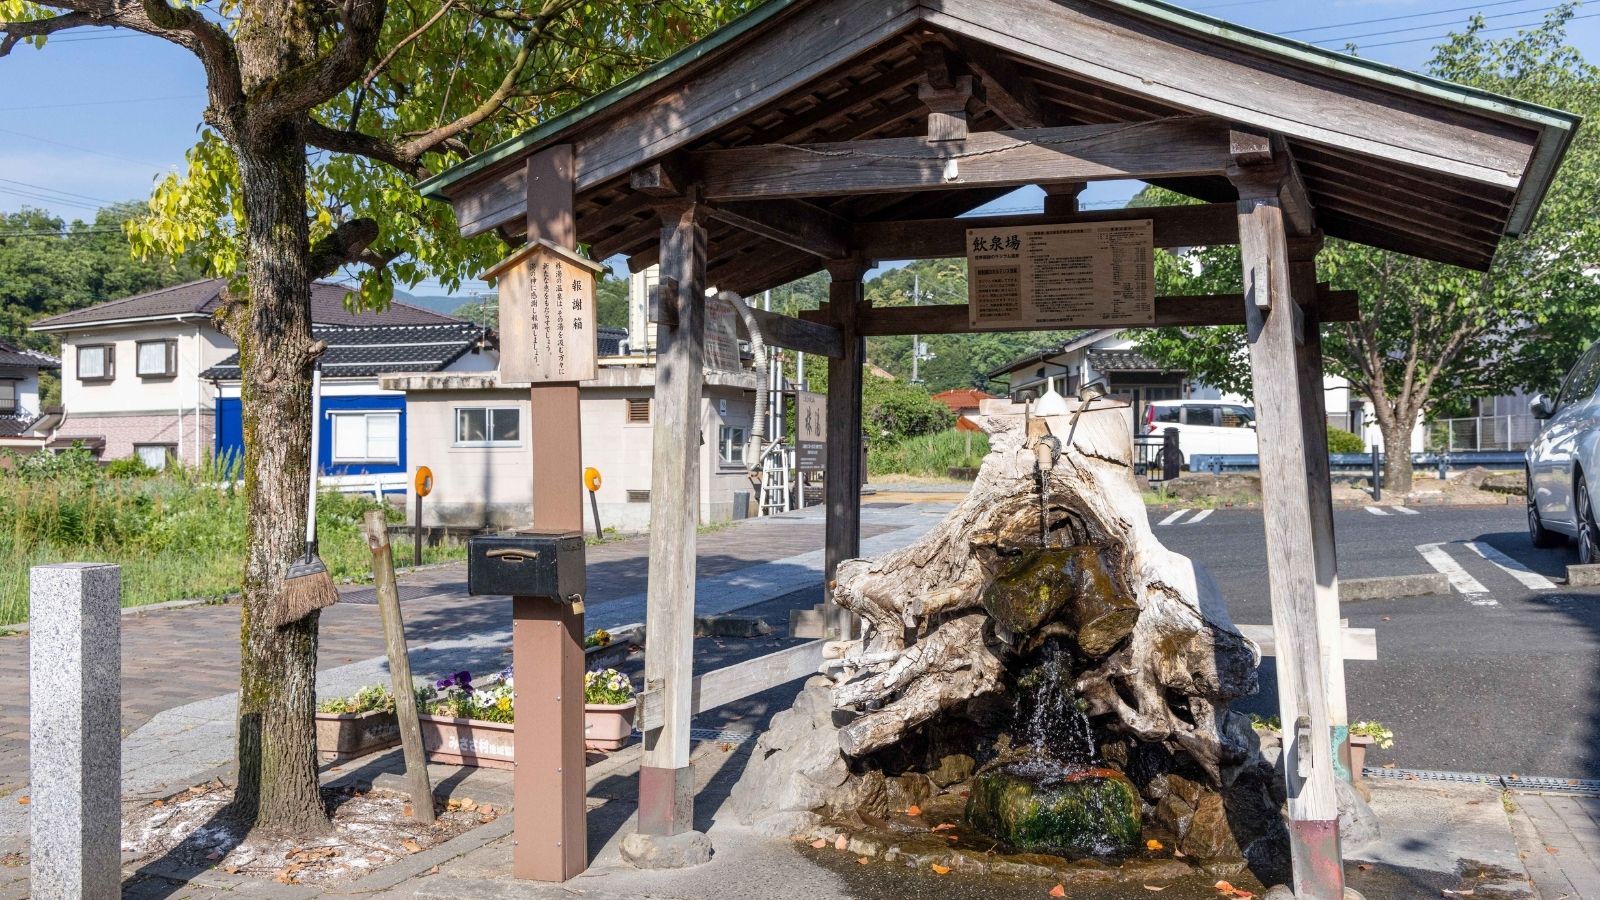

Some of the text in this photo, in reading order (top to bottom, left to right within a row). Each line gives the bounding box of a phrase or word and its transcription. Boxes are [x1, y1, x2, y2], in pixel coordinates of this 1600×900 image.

[973, 235, 1021, 252] 飲泉場
[572, 280, 583, 330] 報謝箱
